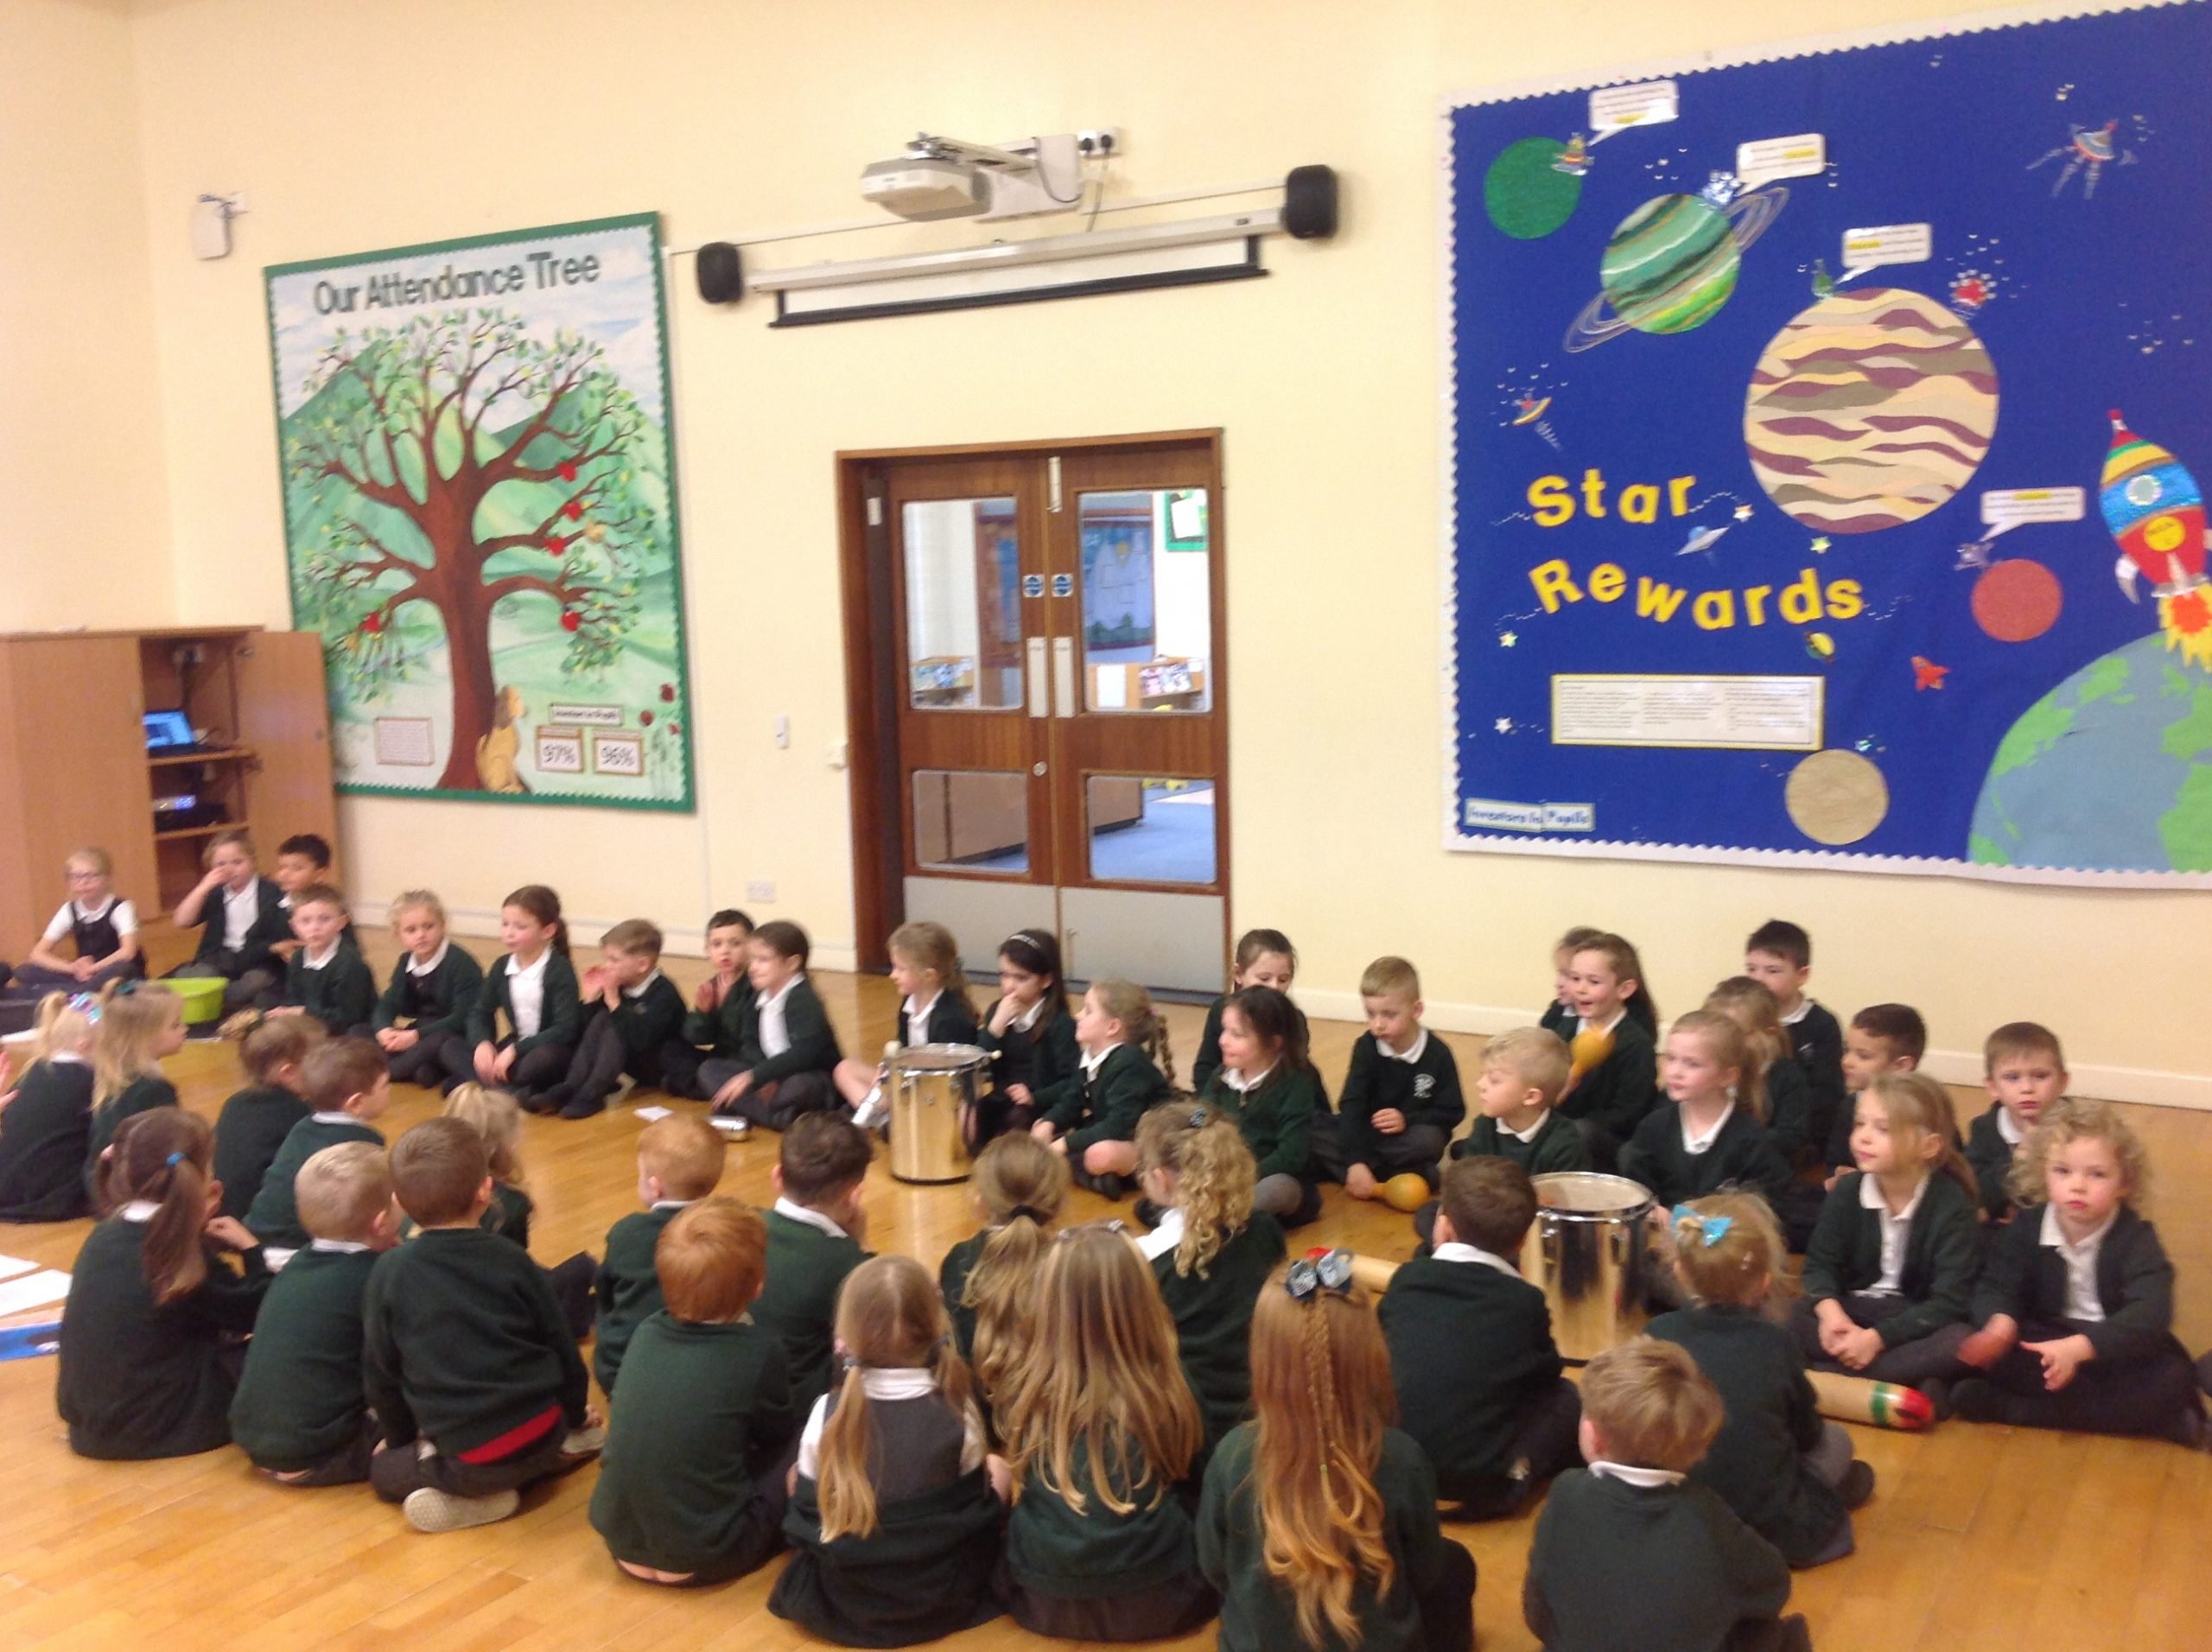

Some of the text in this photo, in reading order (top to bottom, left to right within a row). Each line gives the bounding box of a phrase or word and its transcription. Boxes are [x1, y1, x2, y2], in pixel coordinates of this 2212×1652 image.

[314, 251, 600, 315] Our Attendance Tree
[1527, 468, 1696, 526] Star
[1529, 558, 1865, 630] Rewards
